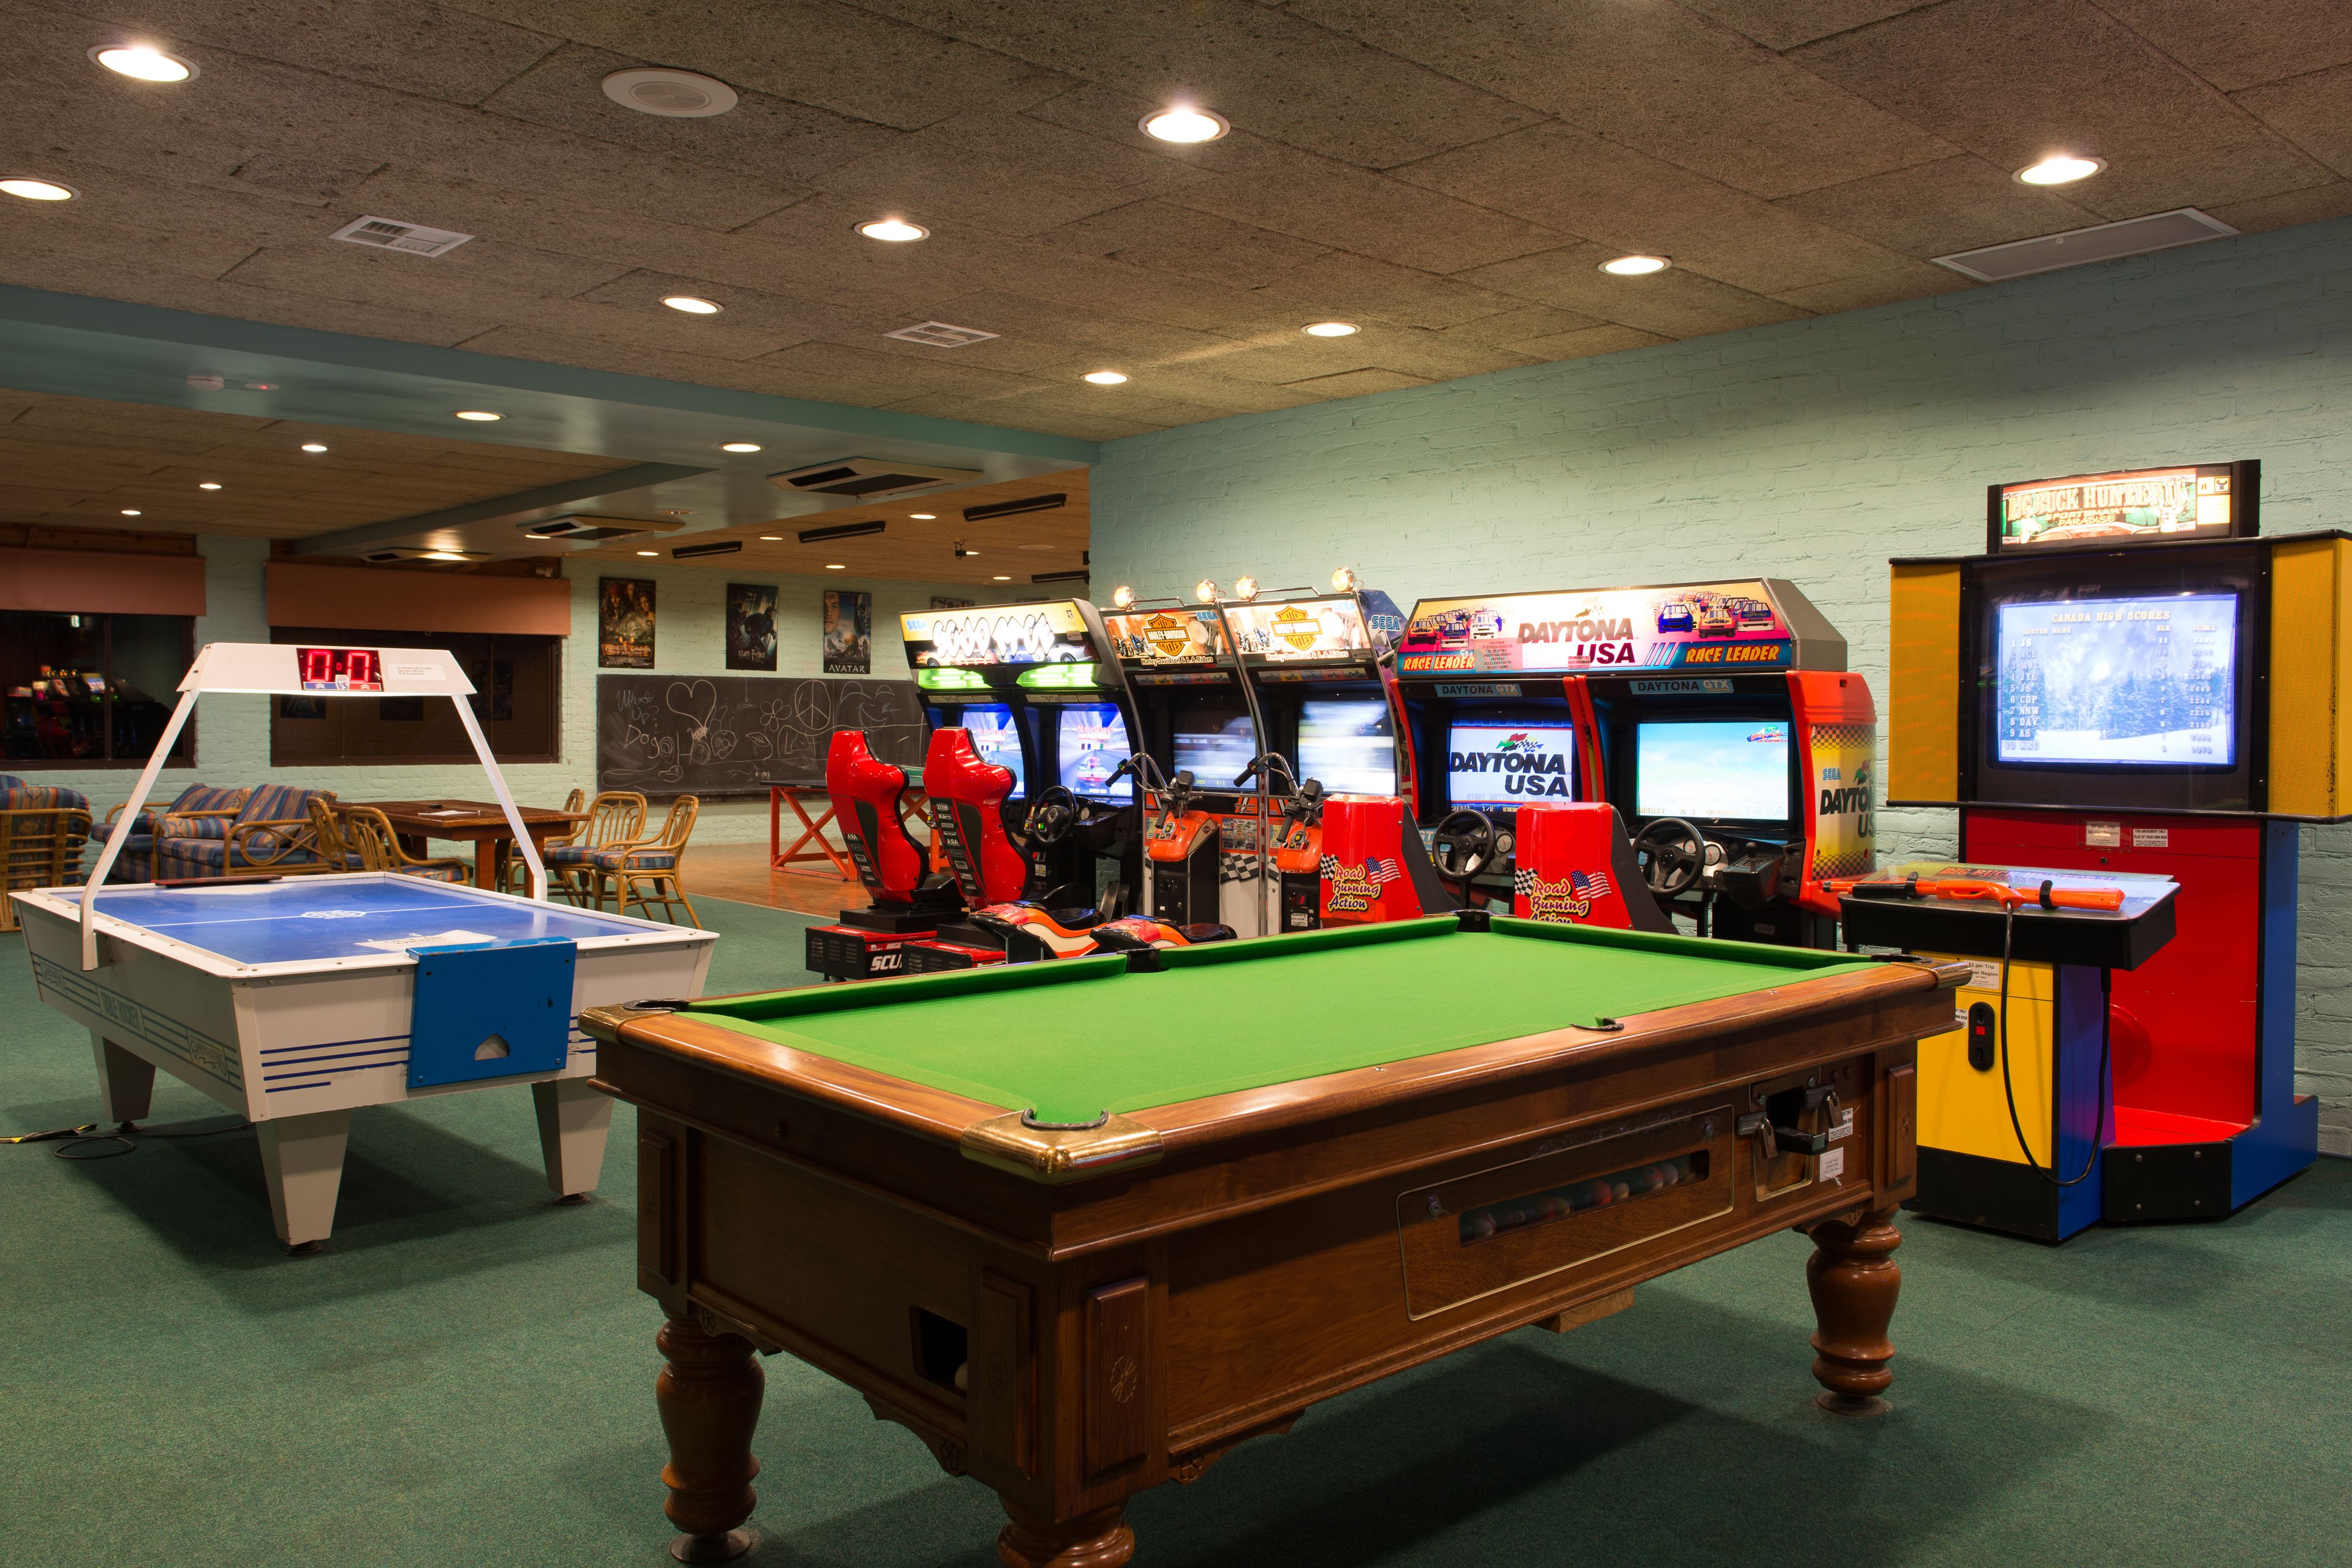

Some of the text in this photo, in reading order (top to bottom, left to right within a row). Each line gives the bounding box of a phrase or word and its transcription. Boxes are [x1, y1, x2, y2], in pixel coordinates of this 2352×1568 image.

[2034, 488, 2079, 513] BUCK
[2082, 482, 2162, 510] HUNTER
[2059, 516, 2117, 527] PARADISE
[1196, 611, 1219, 621] SEGA
[1281, 612, 1304, 620] MOTOR
[1371, 615, 1400, 630] SEGA
[2052, 610, 2171, 623] CANADA HIGH SCORES
[1152, 619, 1174, 628] MOTOR
[1517, 617, 1634, 643] DAYTONA
[1147, 630, 1187, 641] HARLEY-DAVIDSON
[1159, 642, 1182, 653] CYCLES
[1288, 636, 1312, 649] CYCLES
[2021, 639, 2032, 647] JS
[1576, 643, 1636, 665] USA
[1685, 644, 1780, 664] RACE LEADER
[2020, 650, 2037, 658] ACE
[829, 665, 865, 673] AVATAR
[1141, 658, 1181, 667] Harley-Davidson
[1403, 655, 1476, 671] RACE LEADER
[2010, 661, 2016, 669] 3
[337, 682, 348, 690] VS
[1442, 685, 1493, 695] DAYTONA
[1638, 679, 1730, 692] DAYTONA GTX
[616, 690, 654, 711] What
[2019, 706, 2039, 715] NNW
[1450, 752, 1566, 775] DAYTONA
[1822, 767, 1841, 780] SEGA
[1505, 775, 1570, 797] USA
[1744, 805, 1786, 816] SEGA
[1335, 864, 1365, 881] Road
[1332, 879, 1381, 899] Burning
[1532, 877, 1571, 897] Road
[1329, 894, 1368, 911] Action
[1530, 895, 1589, 917] Burning
[870, 954, 902, 971] SCU
[101, 992, 140, 1030] TABLE HOCKEY
[1830, 1126, 1852, 1140] NO REFUNDS
